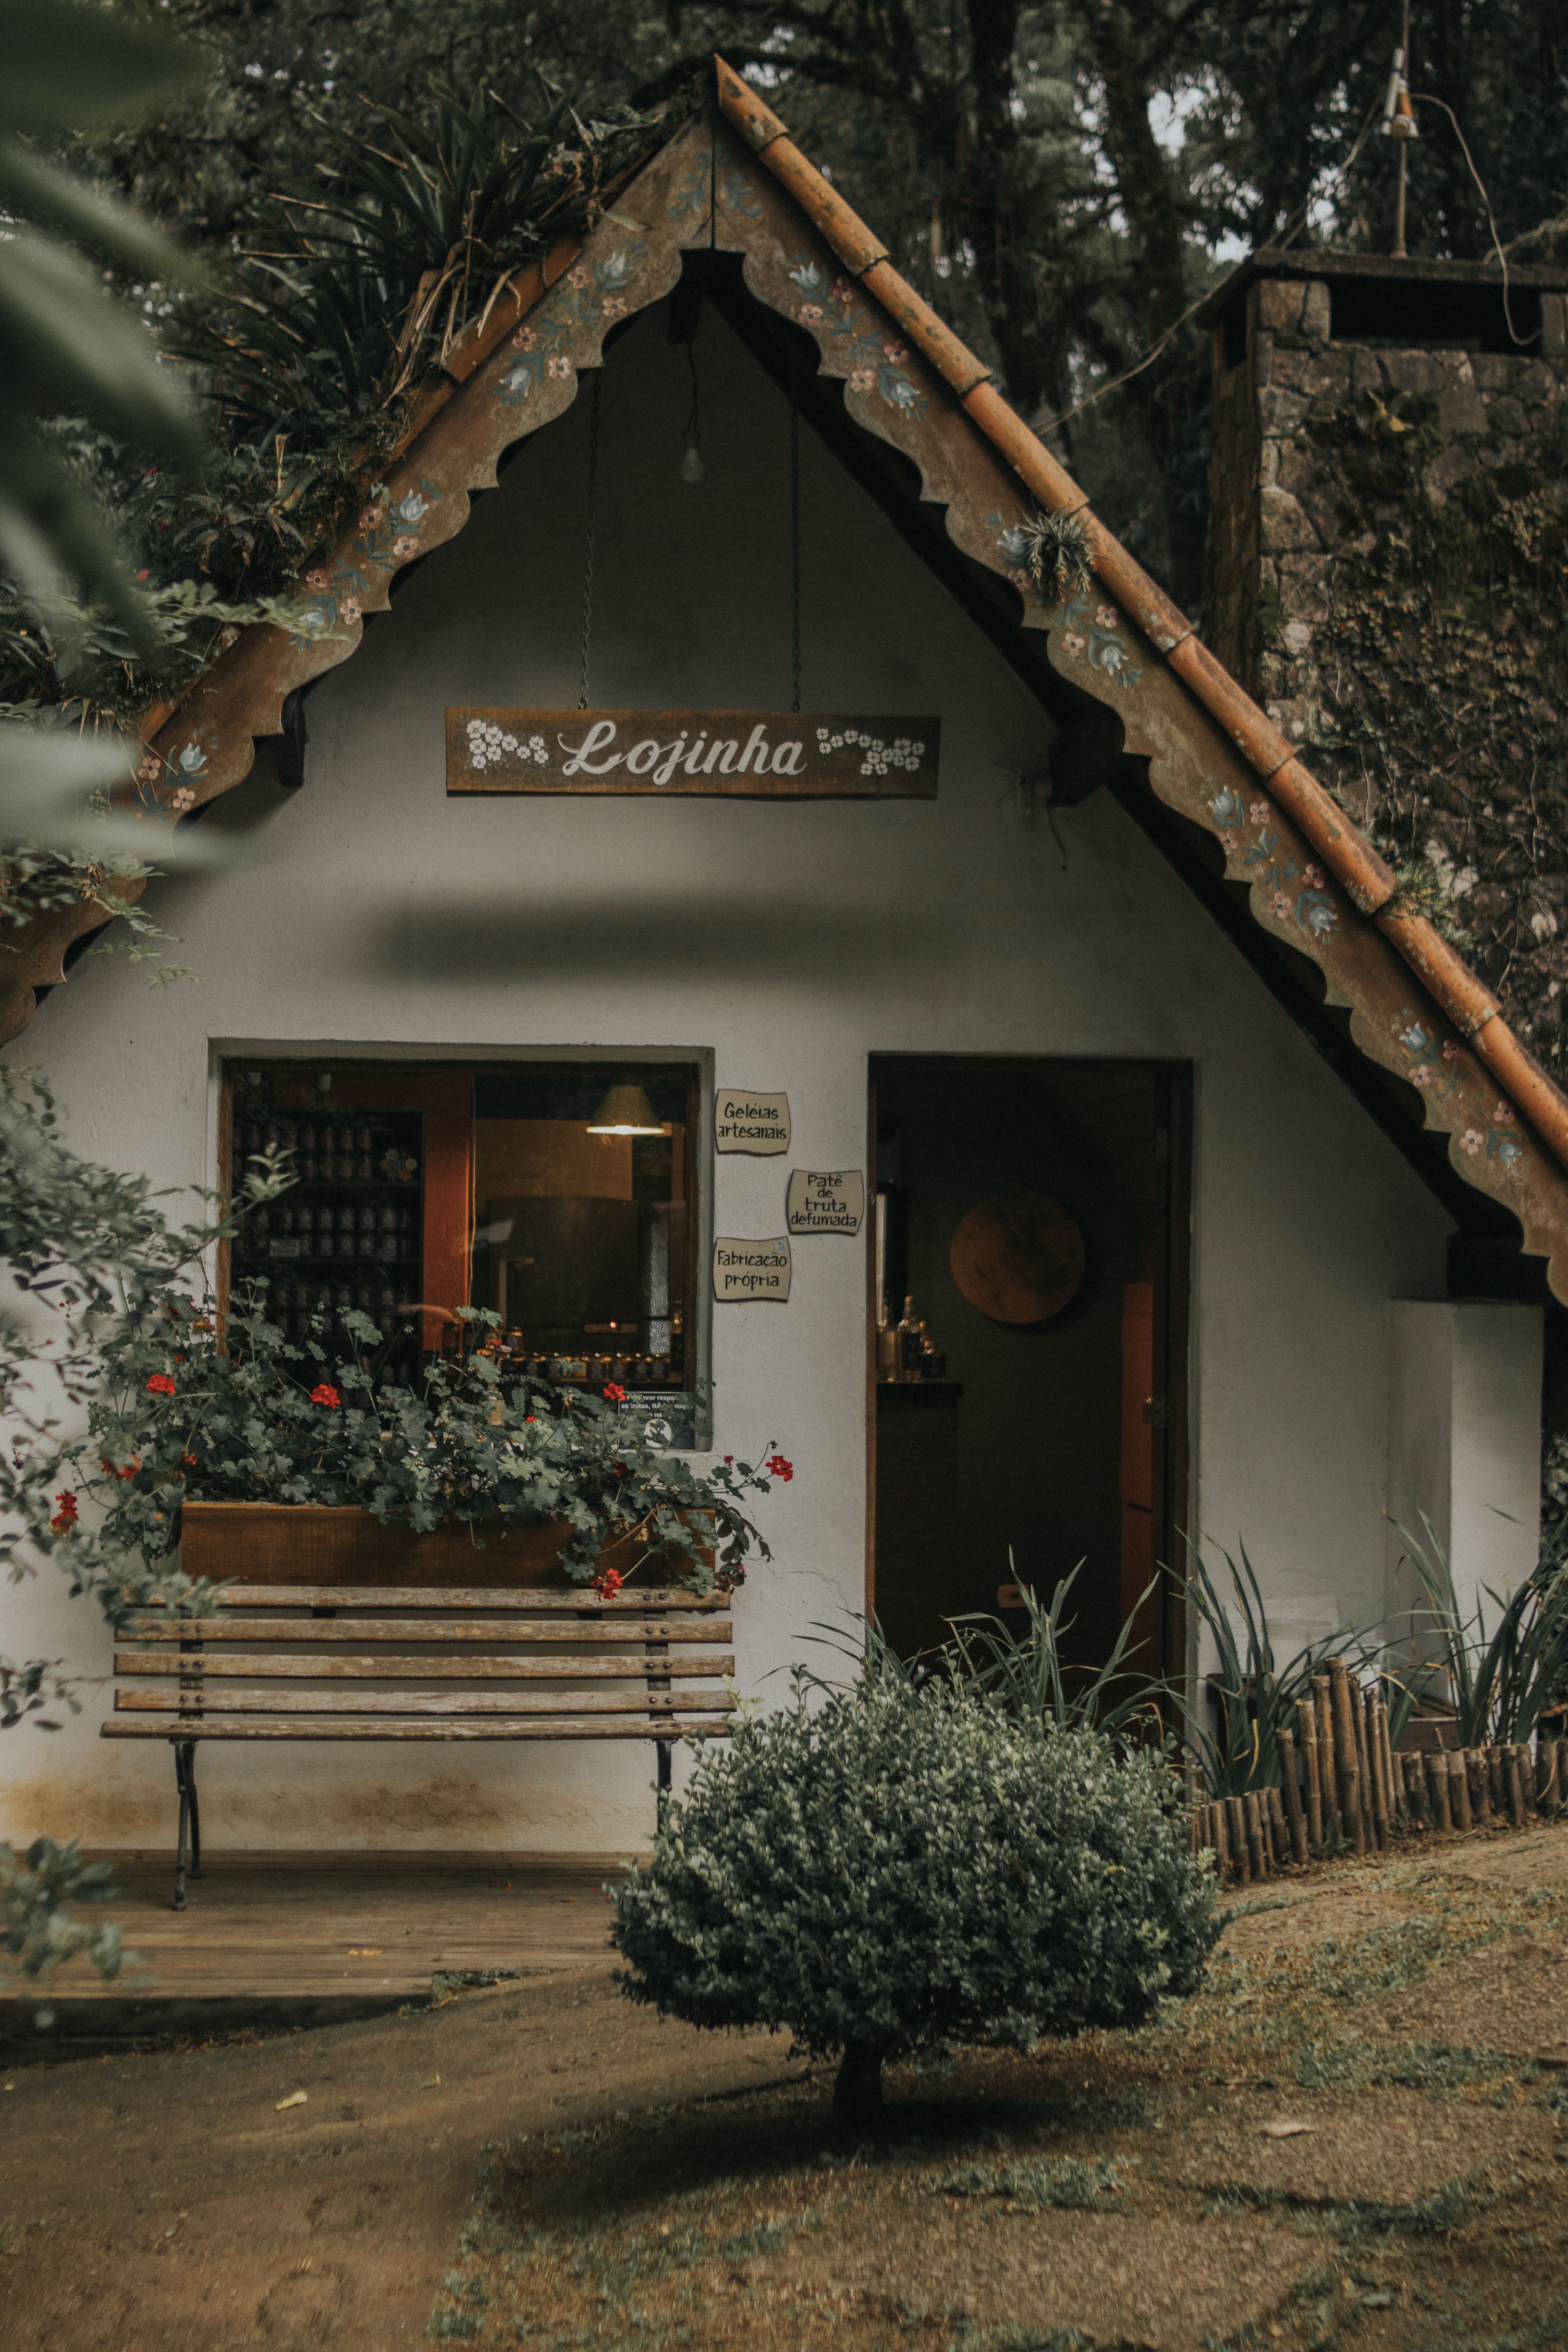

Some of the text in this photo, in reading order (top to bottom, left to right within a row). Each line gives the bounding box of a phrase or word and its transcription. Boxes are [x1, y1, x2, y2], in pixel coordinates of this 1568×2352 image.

[557, 720, 807, 786] Lojinha
[724, 1102, 778, 1120] Geléias
[718, 1123, 786, 1140] artesanais
[808, 1174, 842, 1187] Patê
[817, 1187, 833, 1198] de
[804, 1197, 846, 1212] truta
[791, 1211, 857, 1227] defumada
[718, 1250, 787, 1267] Fabricação
[725, 1271, 779, 1291] própria
